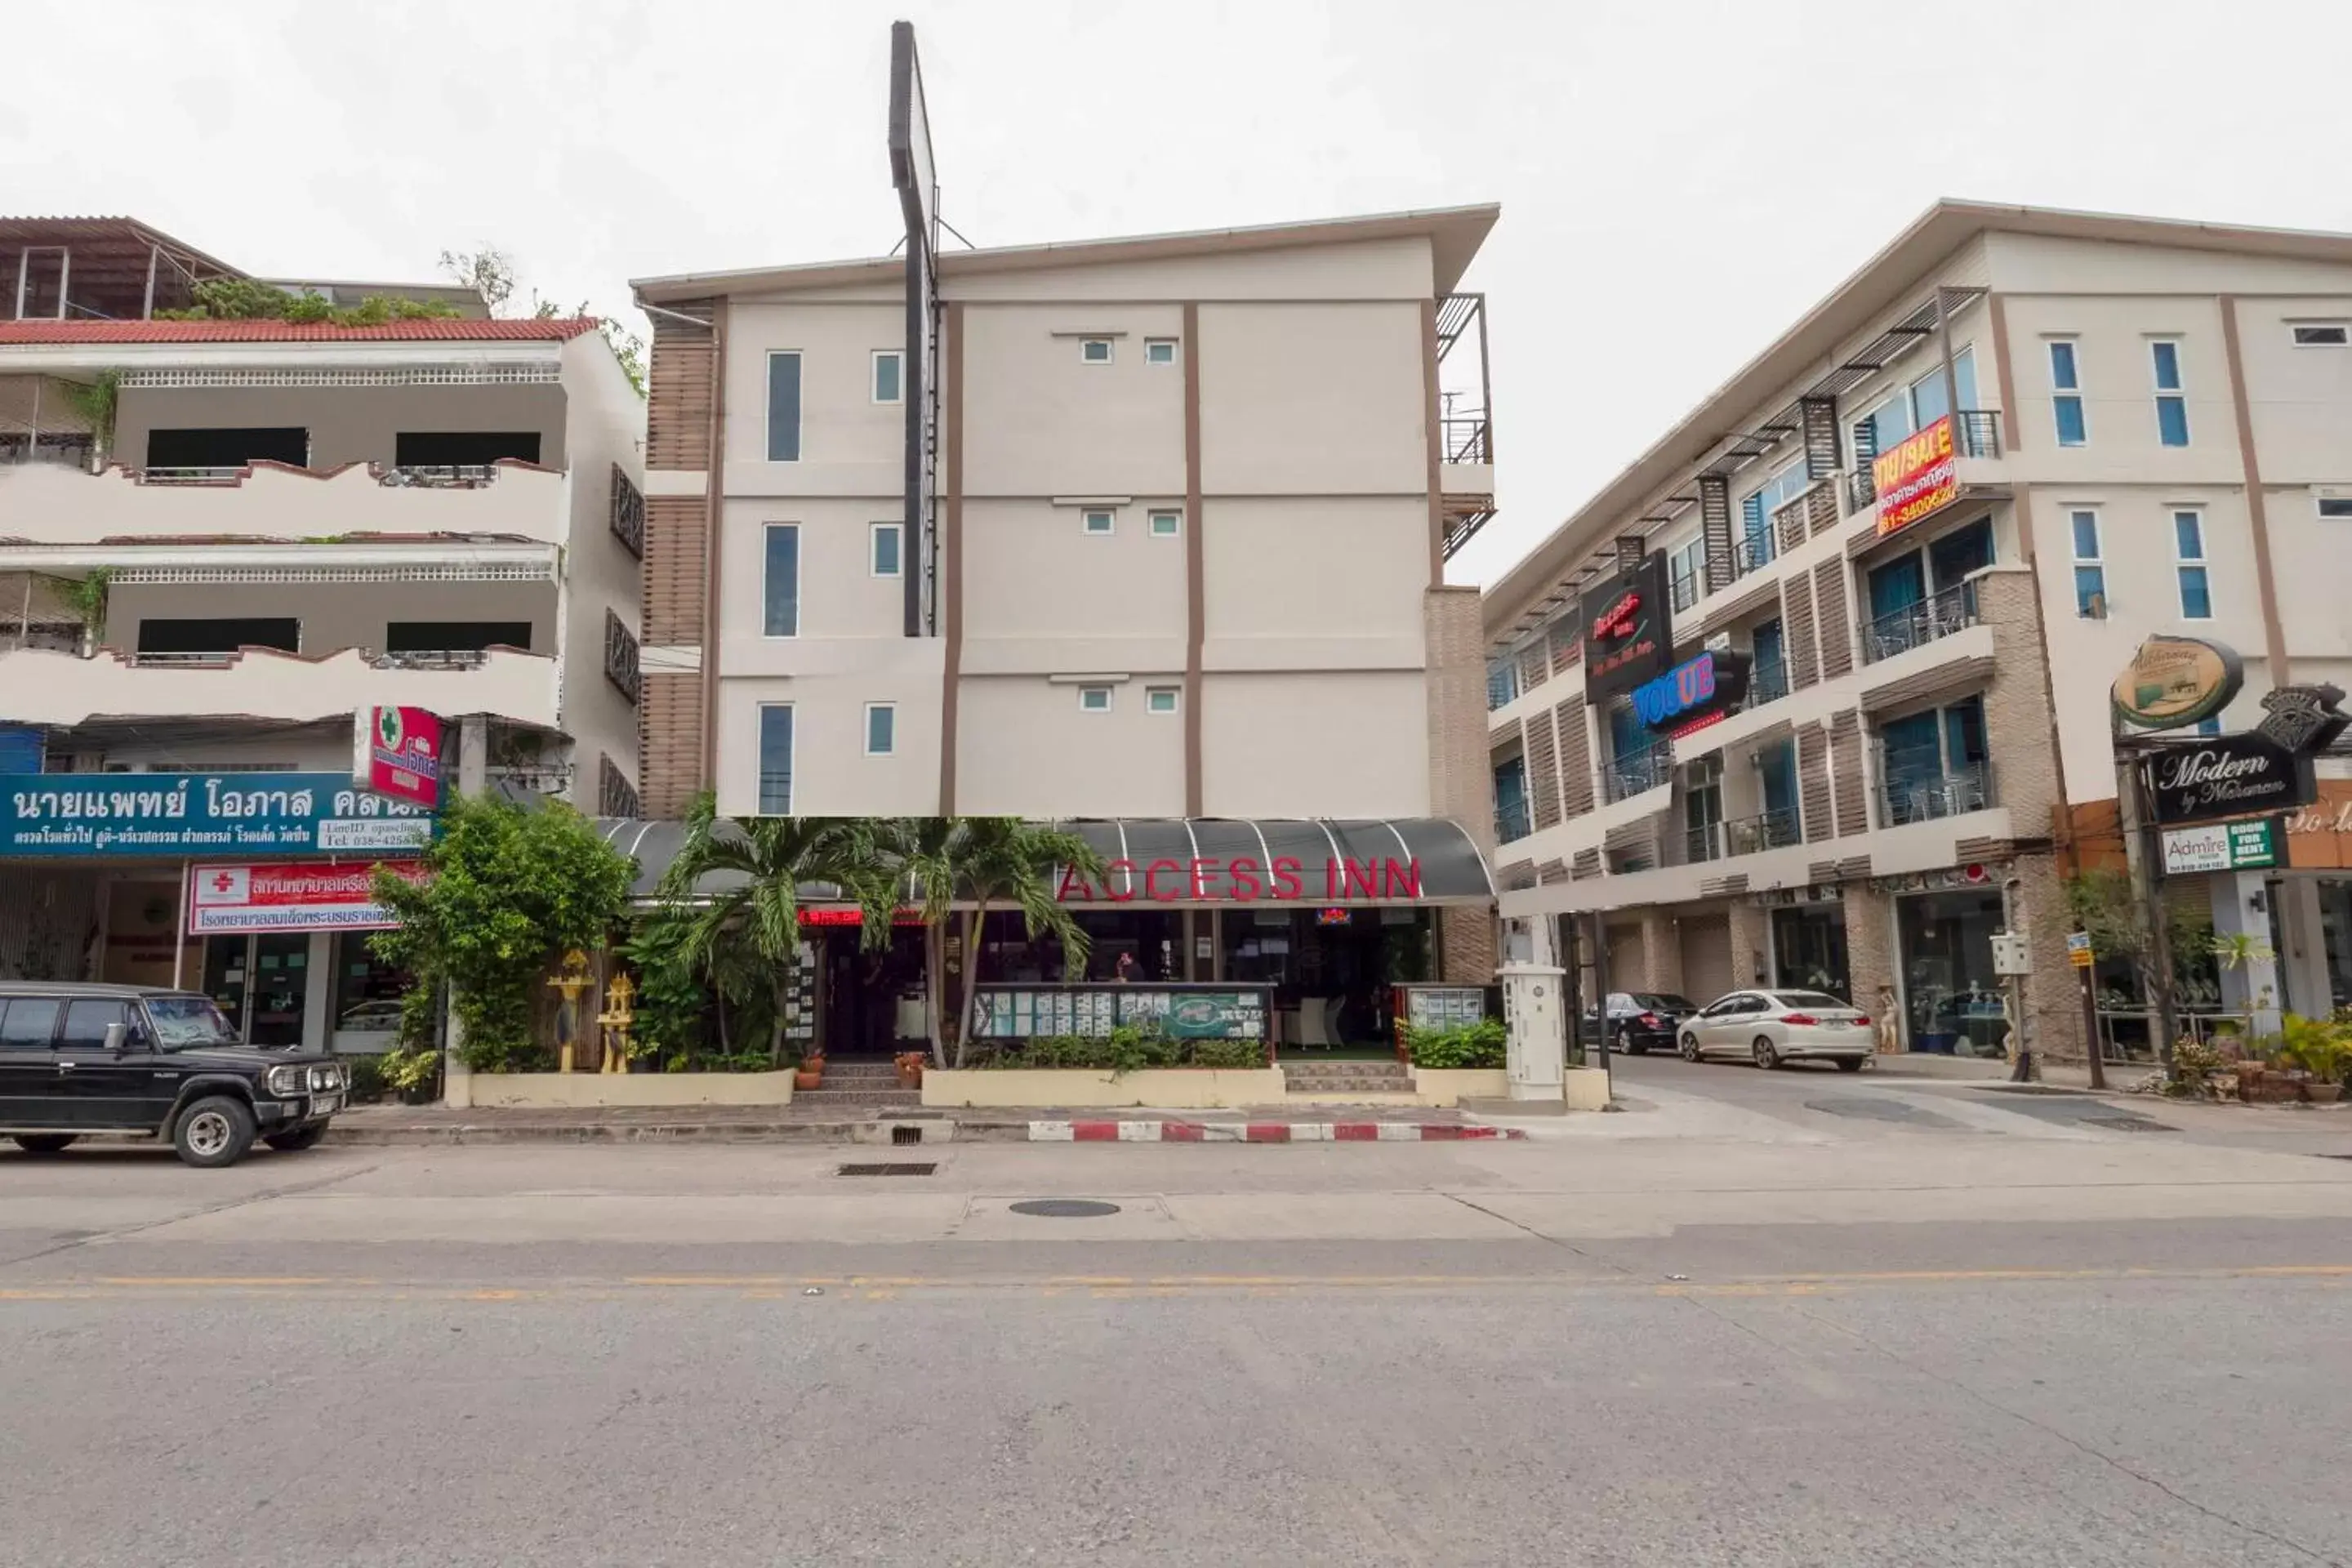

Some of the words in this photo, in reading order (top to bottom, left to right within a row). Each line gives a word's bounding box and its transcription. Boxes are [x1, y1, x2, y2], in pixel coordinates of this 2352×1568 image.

[2158, 751, 2270, 790] Modern
[13, 778, 189, 818] นายแพทย์
[205, 778, 313, 817] โอภาส
[2169, 836, 2226, 858] Admire
[1058, 857, 1303, 902] ACCESS
[1327, 857, 1420, 900] INN
